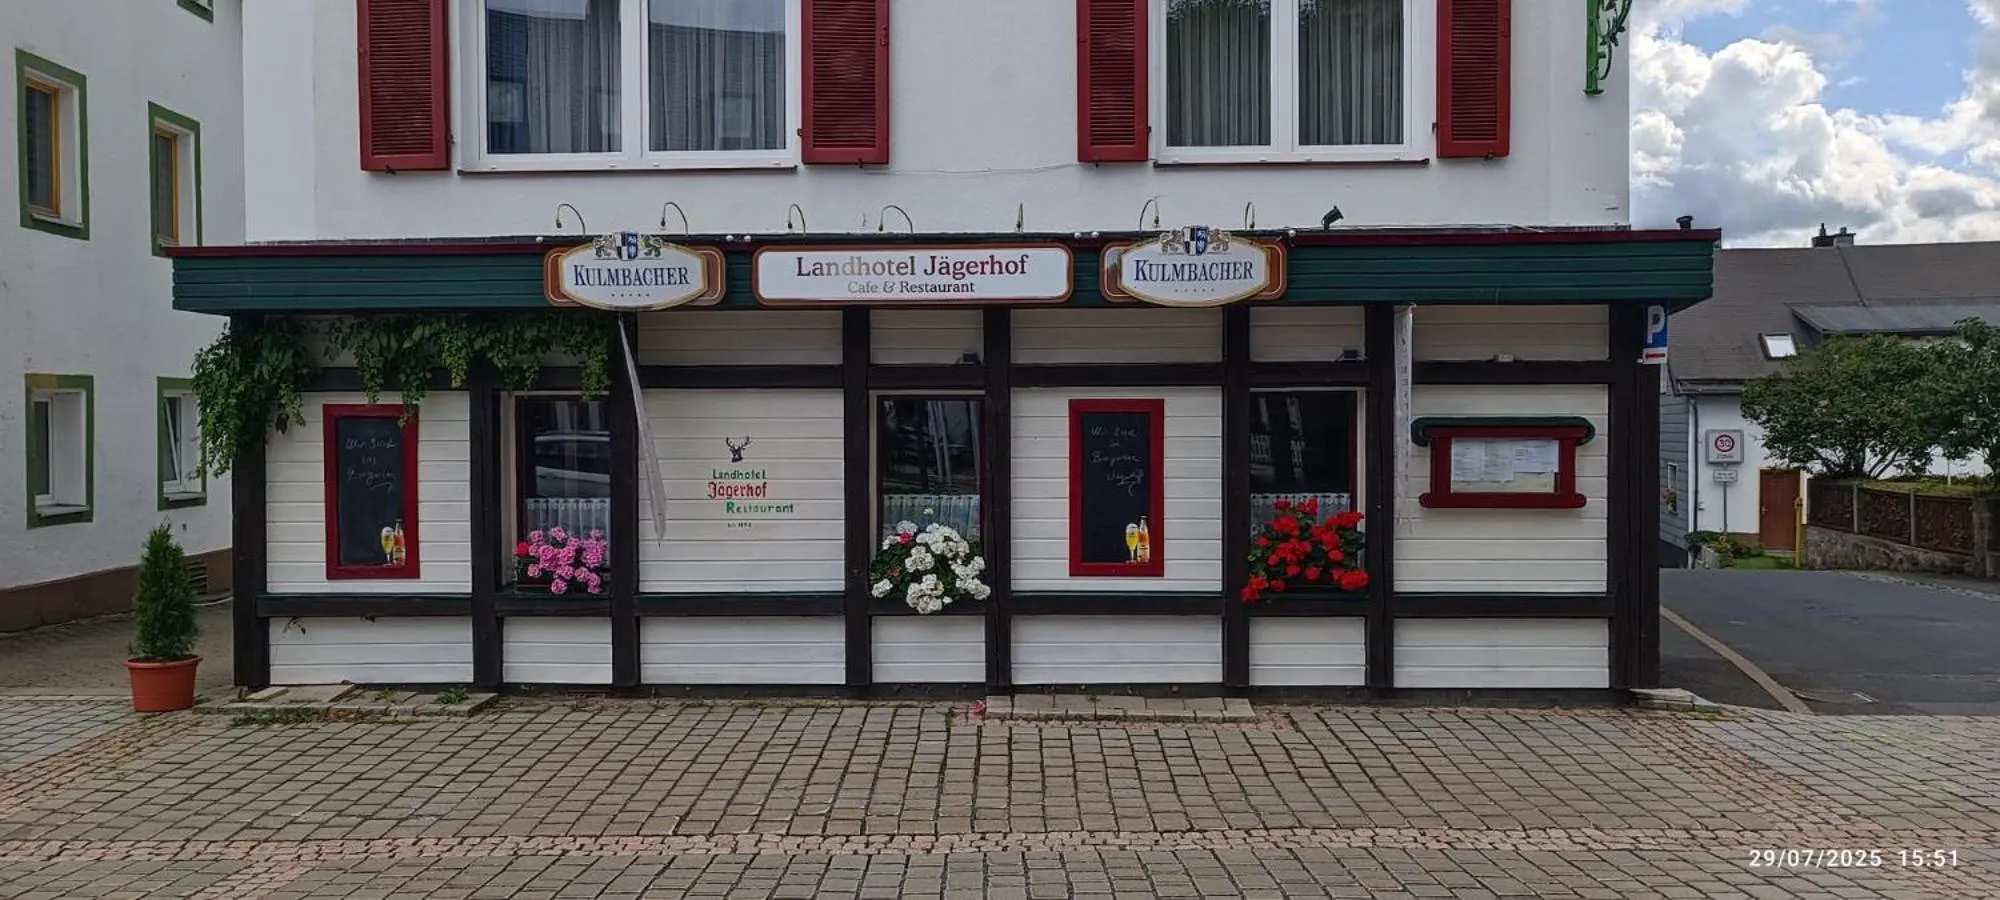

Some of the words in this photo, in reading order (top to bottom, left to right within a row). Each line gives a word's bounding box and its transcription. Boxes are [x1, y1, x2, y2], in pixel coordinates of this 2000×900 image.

[573, 264, 690, 287] KULMBACHER
[796, 255, 916, 277] Landhotel
[923, 254, 1029, 280] Jägerhof
[1134, 259, 1253, 282] KULMBACHER
[848, 281, 878, 294] Cafe
[883, 281, 896, 293] &
[900, 280, 975, 293] Restaurant
[1647, 305, 1665, 344] P
[1718, 438, 1731, 448] 30
[713, 469, 767, 479] Landhotel
[707, 481, 767, 499] Jägerhof
[726, 501, 793, 513] Restaurant
